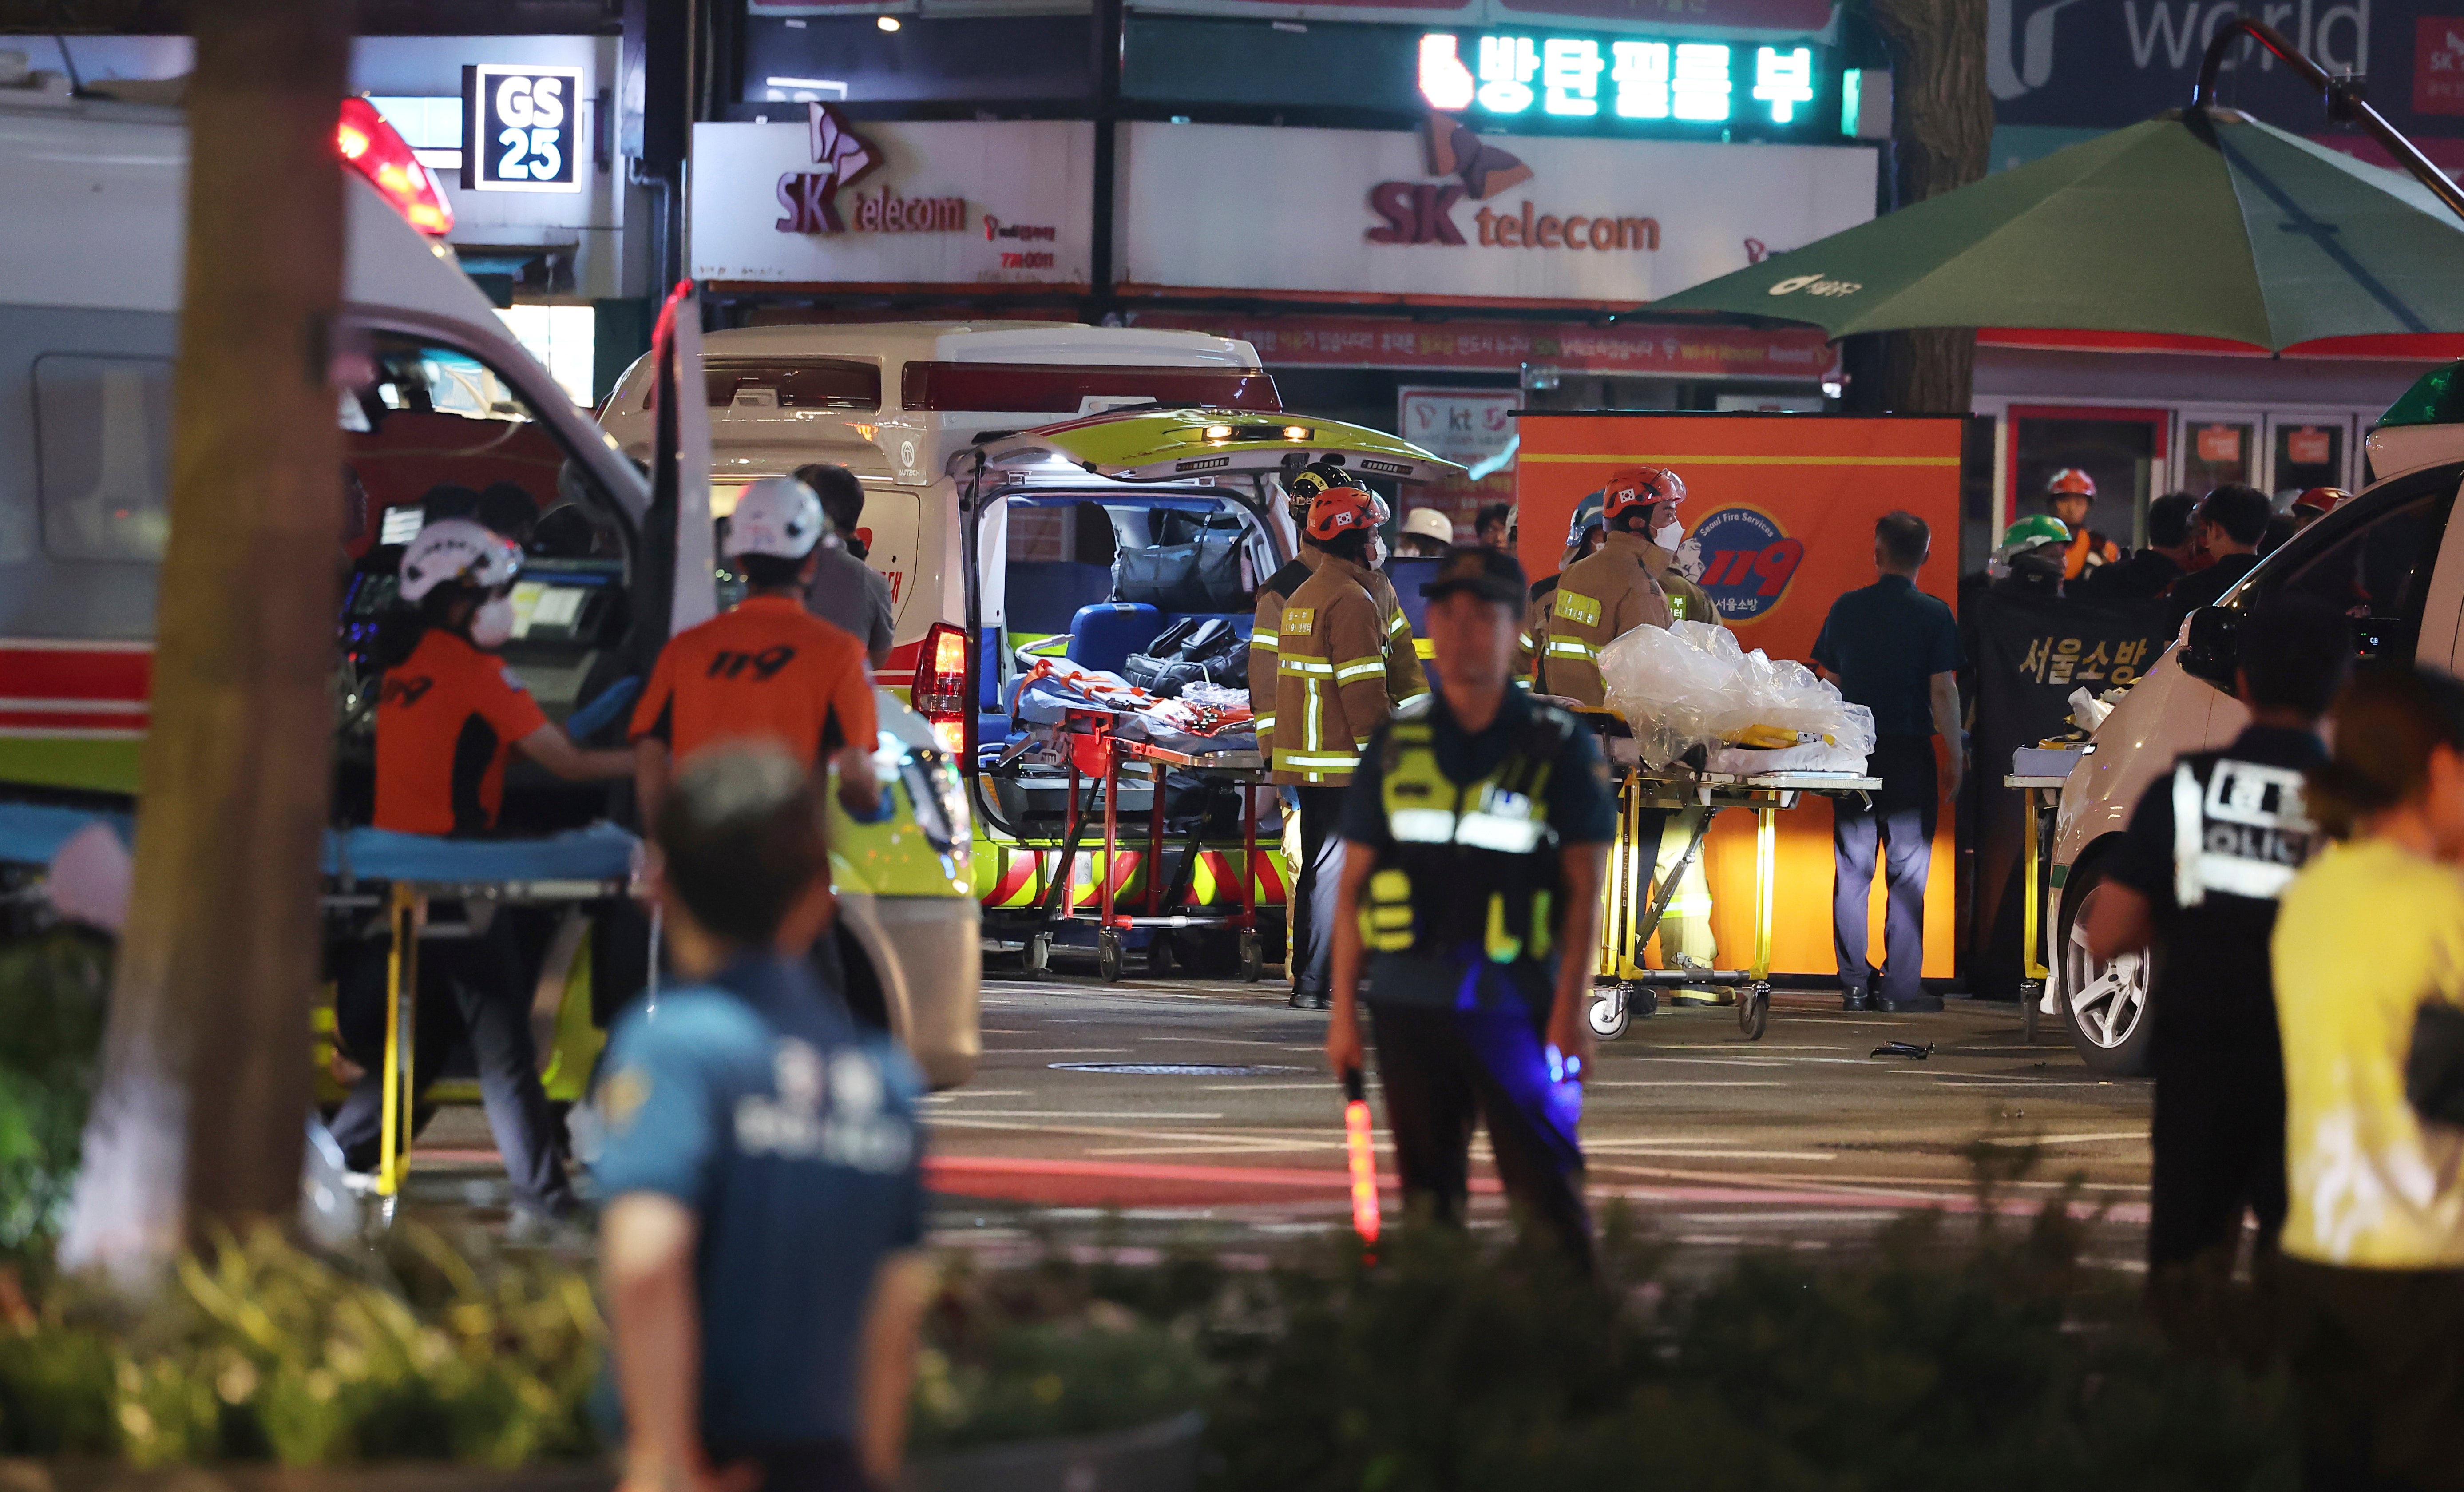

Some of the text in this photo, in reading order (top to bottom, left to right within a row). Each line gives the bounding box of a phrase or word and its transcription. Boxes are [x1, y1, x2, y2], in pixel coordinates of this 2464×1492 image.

[2124, 0, 2370, 76] world
[496, 76, 564, 128] GS
[1478, 36, 1814, 123] 방탄필름 부
[497, 128, 562, 181] 25
[775, 171, 966, 234] SK telecom
[1365, 181, 1661, 251] SK telecom
[1449, 406, 1473, 430] kt
[1699, 512, 1774, 538] Seoul Fire Services
[1699, 538, 1803, 596] 119
[1715, 597, 1759, 612] 서울소방
[706, 644, 798, 682] 119
[2019, 636, 2148, 685] 서울소방
